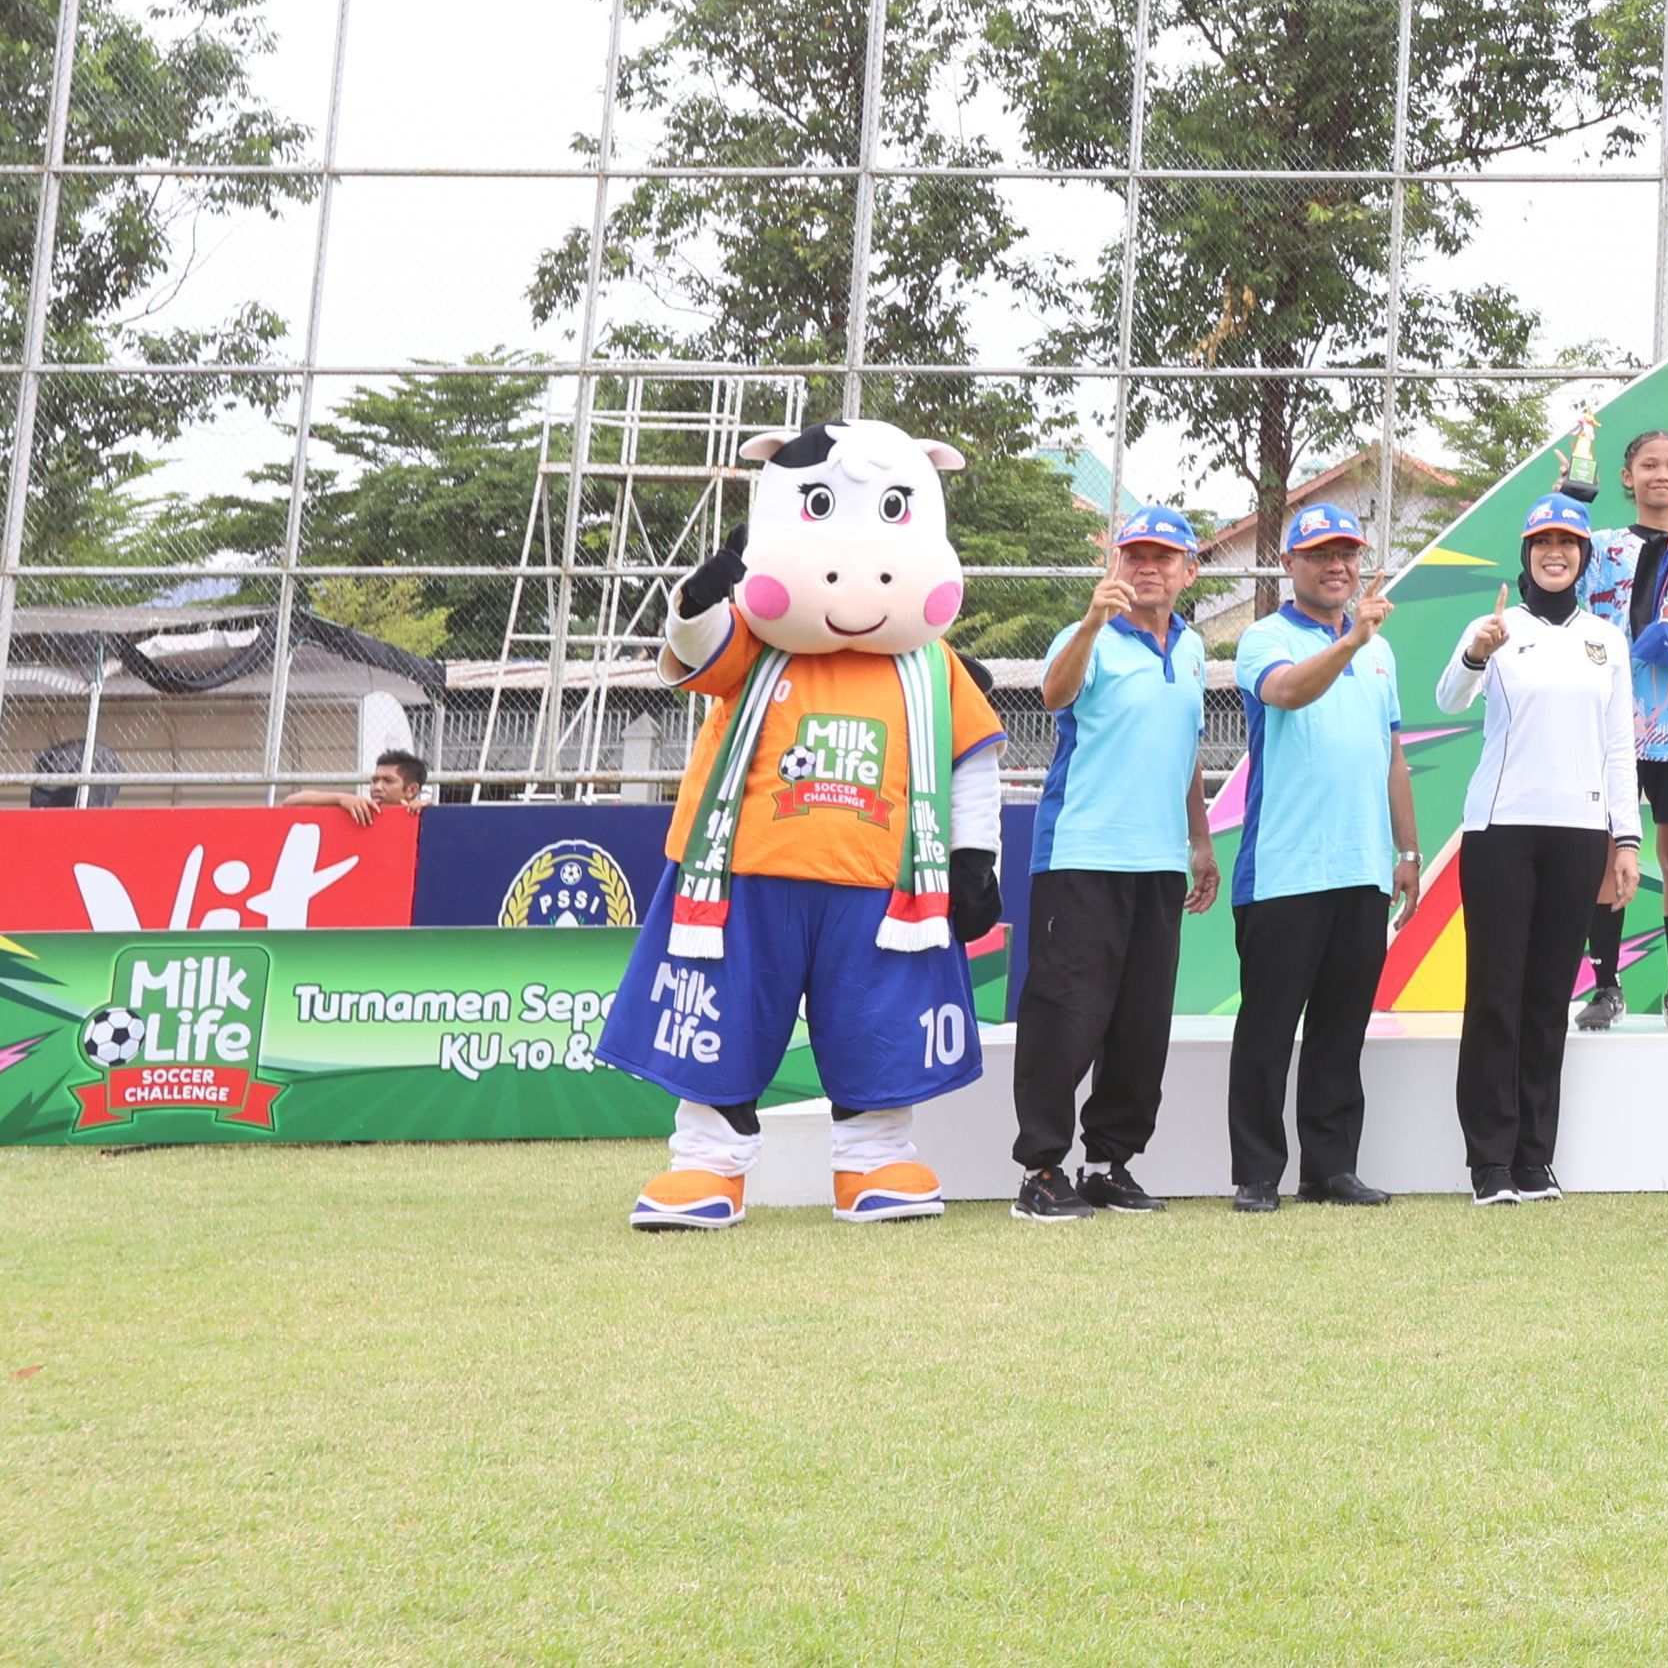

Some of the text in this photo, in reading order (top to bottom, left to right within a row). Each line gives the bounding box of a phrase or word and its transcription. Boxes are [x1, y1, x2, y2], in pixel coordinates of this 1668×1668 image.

[807, 719, 878, 755] Milk
[815, 749, 878, 785] Life
[804, 793, 865, 808] CHALLENGE
[814, 782, 857, 795] SOCCER
[912, 800, 939, 833] ilk
[914, 831, 946, 863] ife
[540, 889, 599, 915] PSSI
[129, 955, 251, 1010] Milk
[650, 962, 721, 1023] Milk
[295, 984, 619, 1032] Turnamen Sep
[143, 1009, 251, 1062] Life
[653, 1007, 722, 1064] Life
[918, 1003, 966, 1068] 10
[440, 1033, 501, 1081] KU
[511, 1041, 553, 1070] 10
[565, 1032, 595, 1073] &
[125, 1086, 230, 1102] CHALLENGE
[141, 1068, 215, 1085] SOCCER
